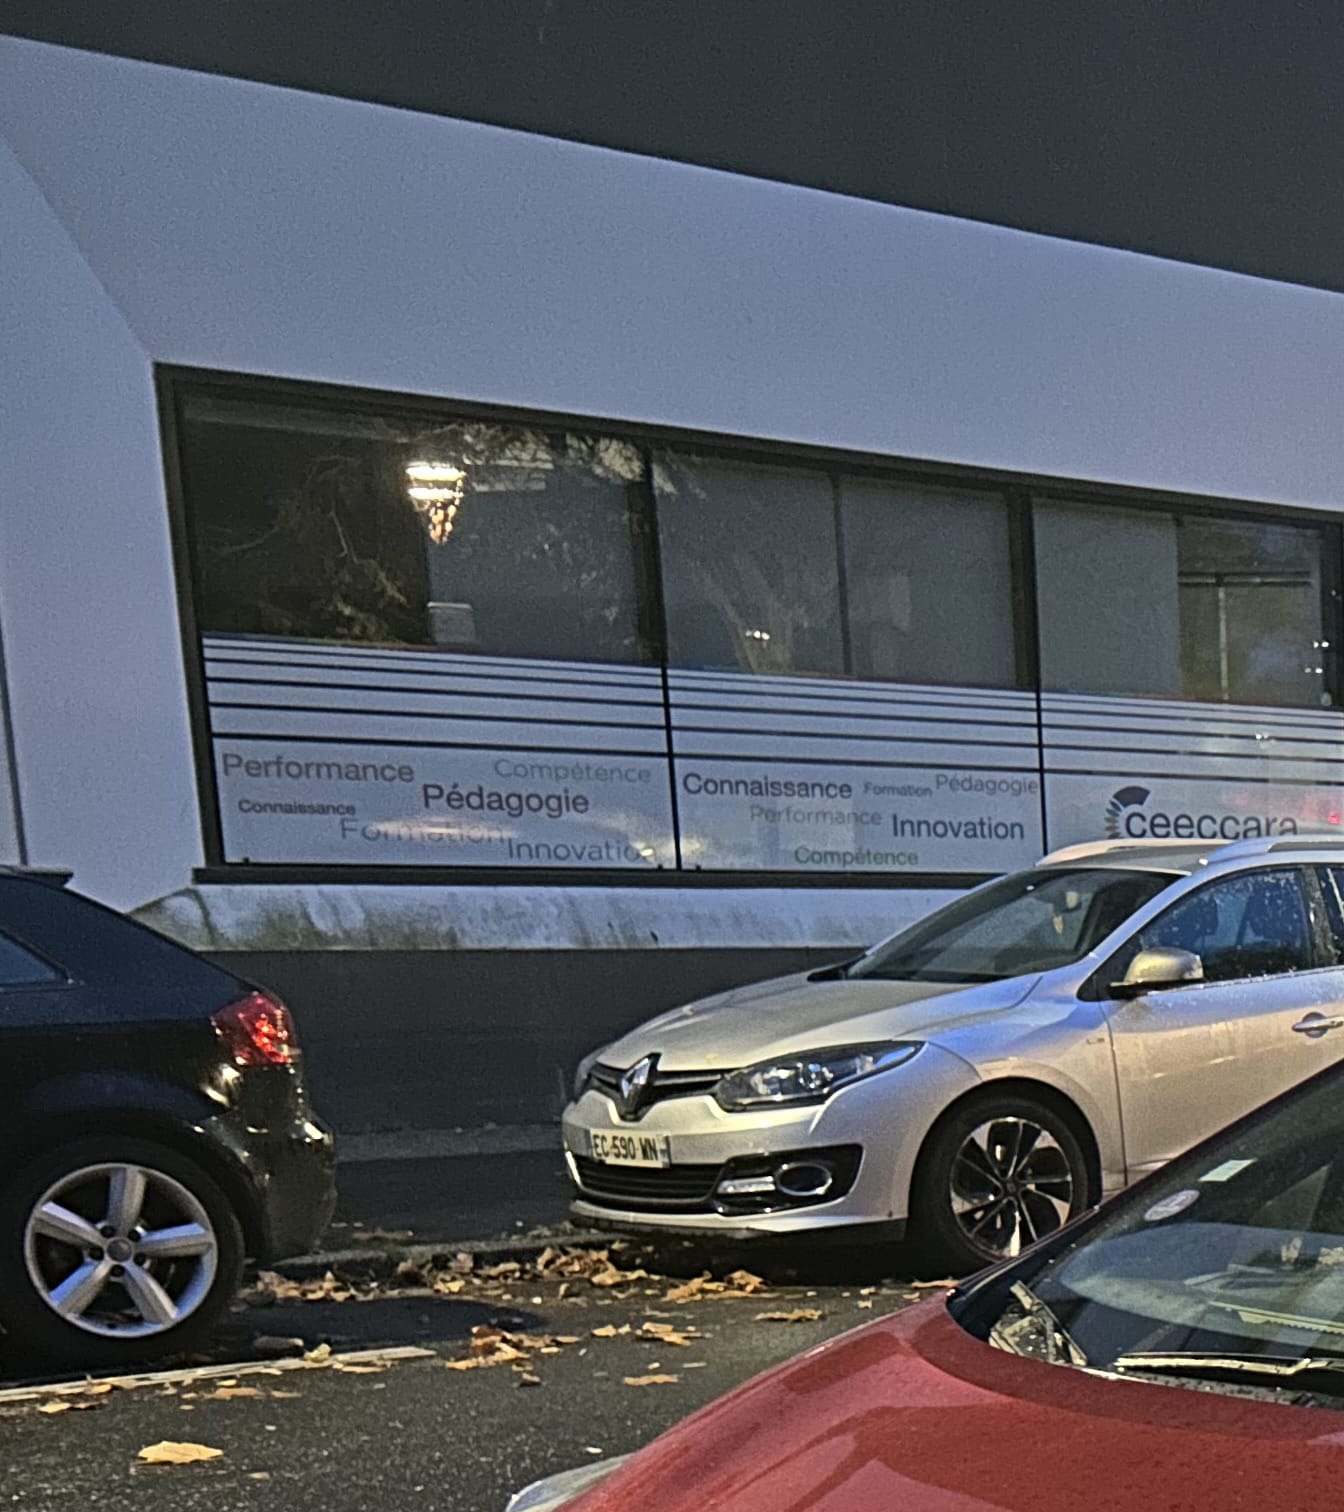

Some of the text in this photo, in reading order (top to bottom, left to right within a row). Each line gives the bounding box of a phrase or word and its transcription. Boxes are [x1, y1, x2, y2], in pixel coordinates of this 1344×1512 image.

[222, 753, 415, 783] Performance
[494, 759, 651, 784] Compétence
[683, 772, 853, 799] Connaissance
[864, 781, 933, 797] Formation
[936, 773, 1039, 796] Pédagogie
[238, 798, 356, 816] Connaissance
[422, 782, 590, 818] Pédagogie
[751, 804, 883, 826] Performance
[892, 813, 1025, 840] Innovation
[1125, 811, 1298, 840] ceeccara
[795, 846, 919, 867] Compétence
